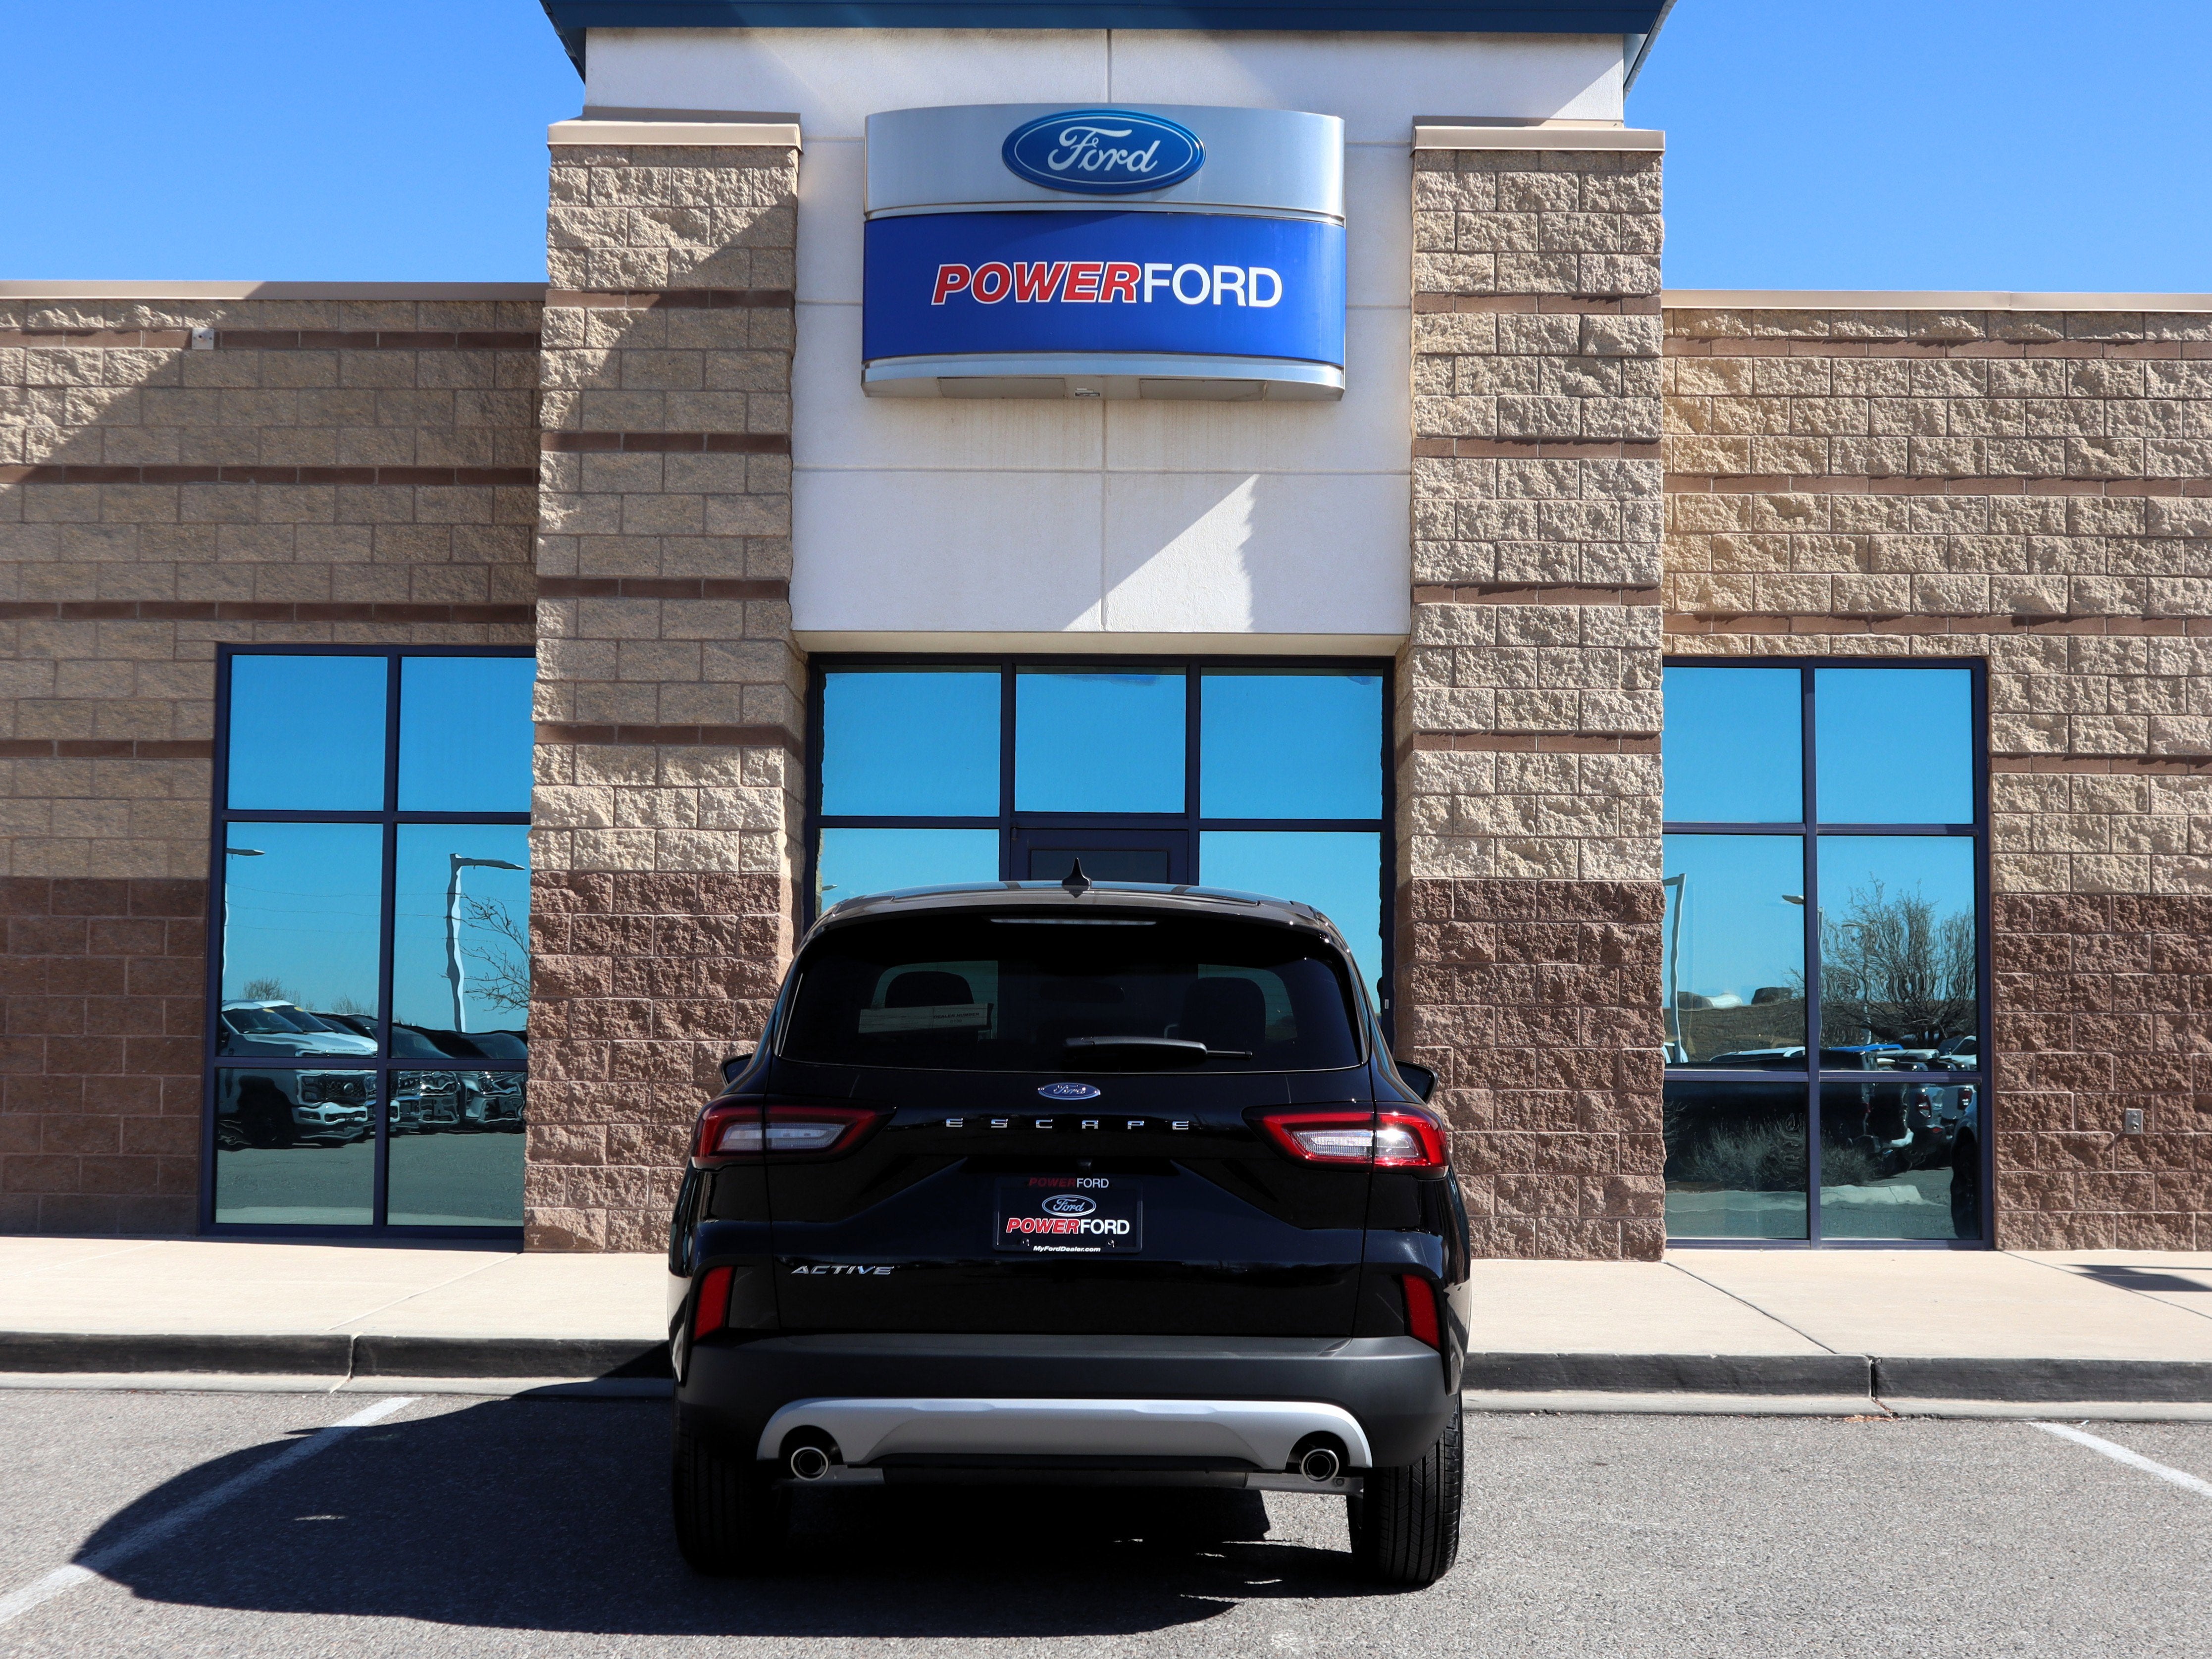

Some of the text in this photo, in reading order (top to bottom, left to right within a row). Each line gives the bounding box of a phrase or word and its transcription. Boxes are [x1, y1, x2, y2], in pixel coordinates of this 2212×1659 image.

[1046, 126, 1160, 173] Ford
[1053, 1085, 1087, 1094] Ford
[945, 1117, 1189, 1130] ESCAPE
[1053, 1198, 1085, 1212] Ford
[791, 1265, 894, 1275] ACTIVE
